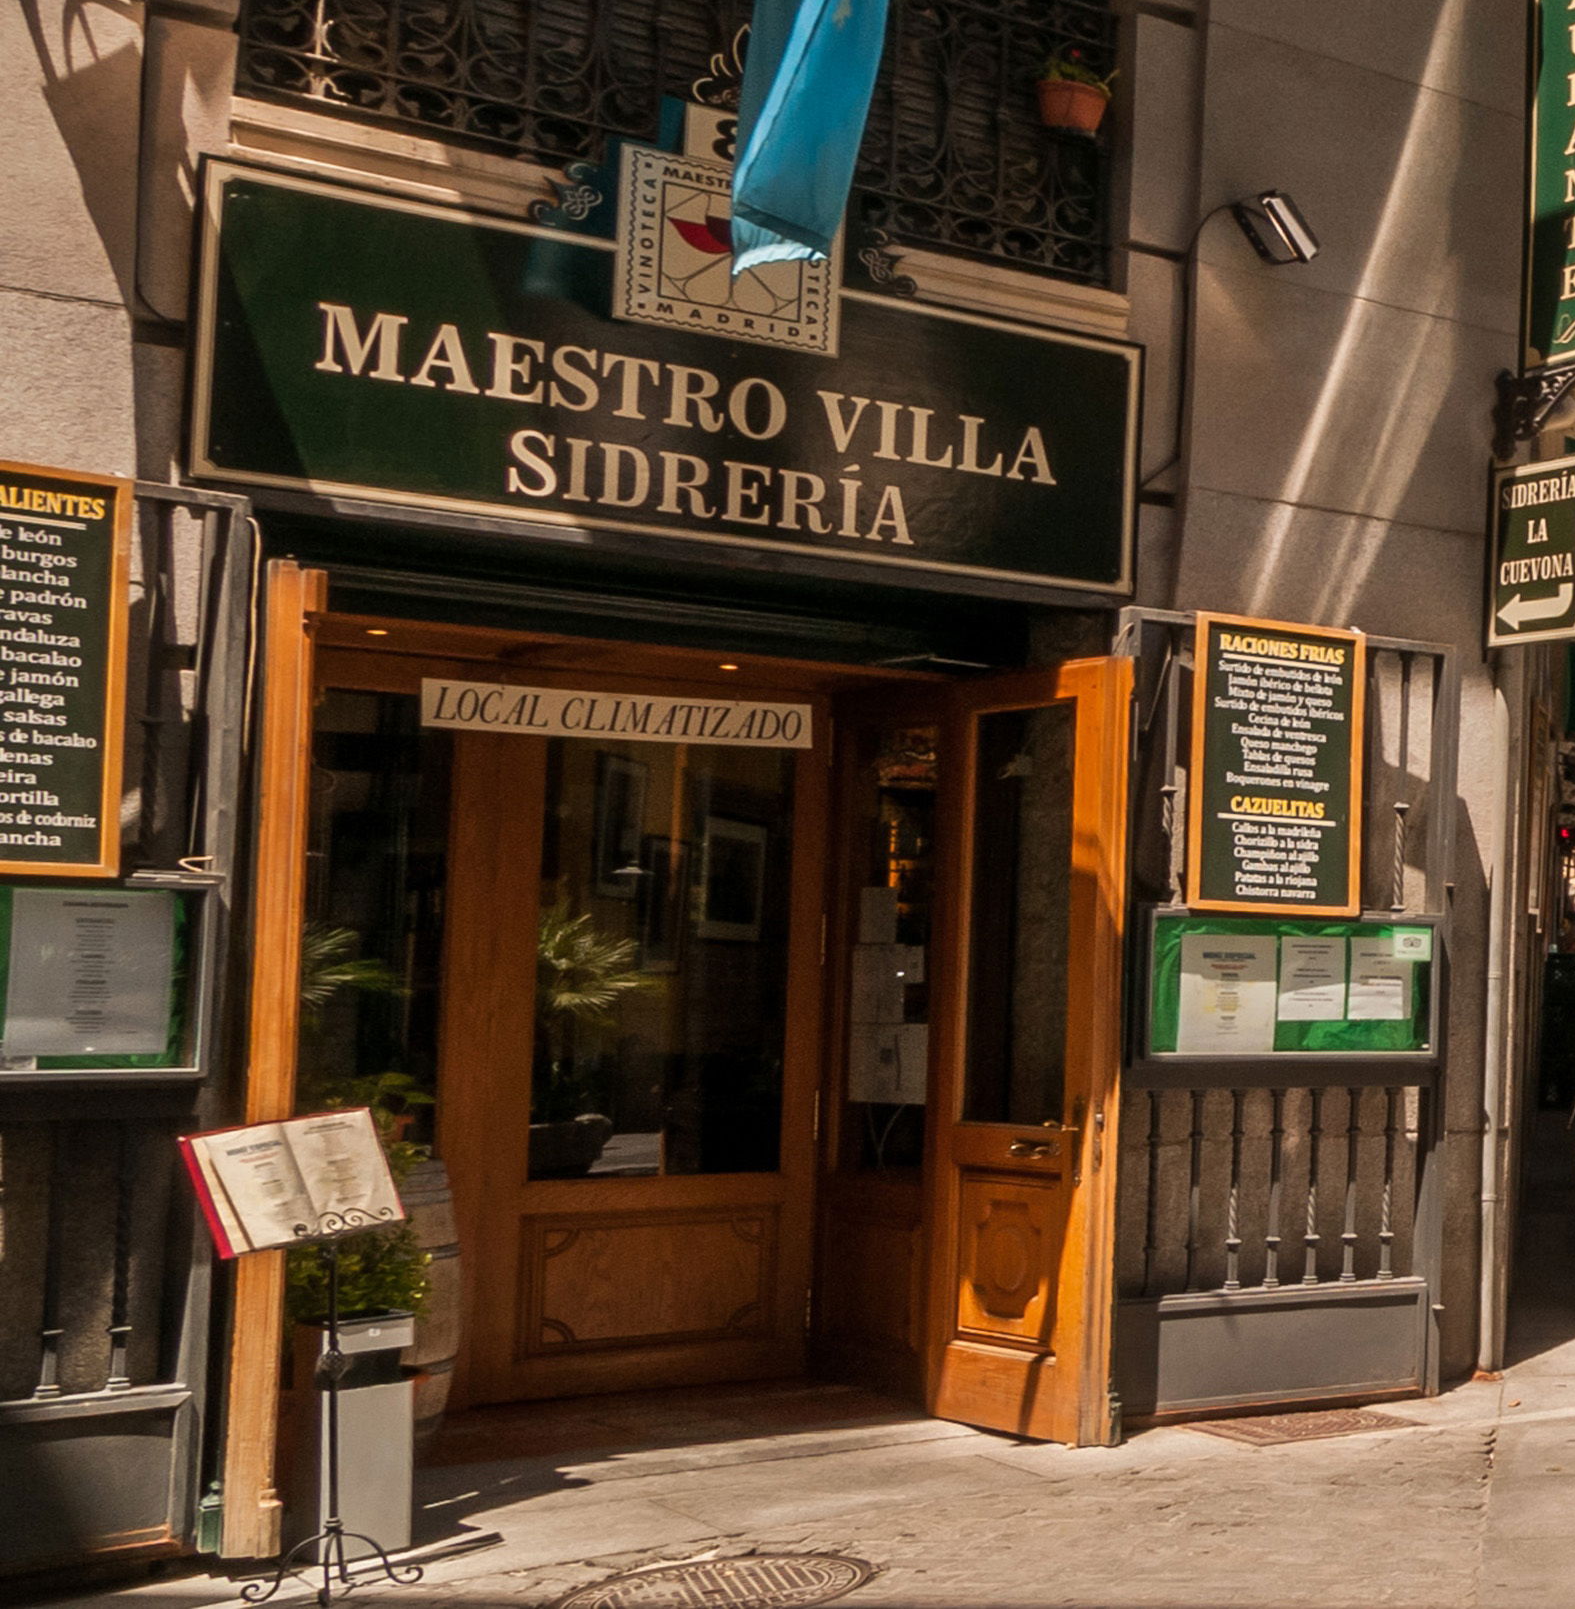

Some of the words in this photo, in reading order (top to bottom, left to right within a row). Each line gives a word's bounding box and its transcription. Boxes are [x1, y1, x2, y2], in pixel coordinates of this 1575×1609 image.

[662, 165, 733, 190] MAEST
[637, 178, 658, 296] VINOTECA
[804, 259, 820, 326] OTECA
[655, 301, 801, 338] MADRID
[314, 301, 788, 441] MAESTRO
[816, 389, 1059, 486] VILLA
[506, 429, 916, 546] SIDRERÍA
[0, 485, 106, 520] ALIENTES
[18, 526, 62, 547] león
[1526, 517, 1549, 544] LA
[2, 544, 78, 568] burgos
[0, 565, 70, 587] lancha
[1499, 552, 1574, 586] CUEVONA
[10, 589, 87, 609] padrón
[0, 628, 81, 648] ndaluza
[1, 646, 82, 668] bacalao
[1219, 633, 1298, 659] RACIONES
[1300, 645, 1345, 665] FRIAS
[10, 667, 79, 688] jamón
[1253, 662, 1263, 675] de
[1312, 669, 1322, 683] de
[1256, 688, 1267, 701] de
[1292, 679, 1303, 693] de
[431, 686, 549, 729] LOCAL
[560, 696, 804, 740] CLIMATIZADO
[1249, 698, 1260, 712] de
[3, 709, 67, 727] salsas
[1280, 715, 1291, 728] de
[8, 728, 28, 744] de
[32, 730, 97, 749] bacalao
[1272, 726, 1283, 739] de
[1272, 751, 1282, 764] de
[1283, 777, 1294, 788] en
[0, 790, 59, 807] ortilla
[1230, 795, 1325, 819] CAZUELITAS
[16, 810, 32, 826] de
[34, 812, 97, 829] codorniz
